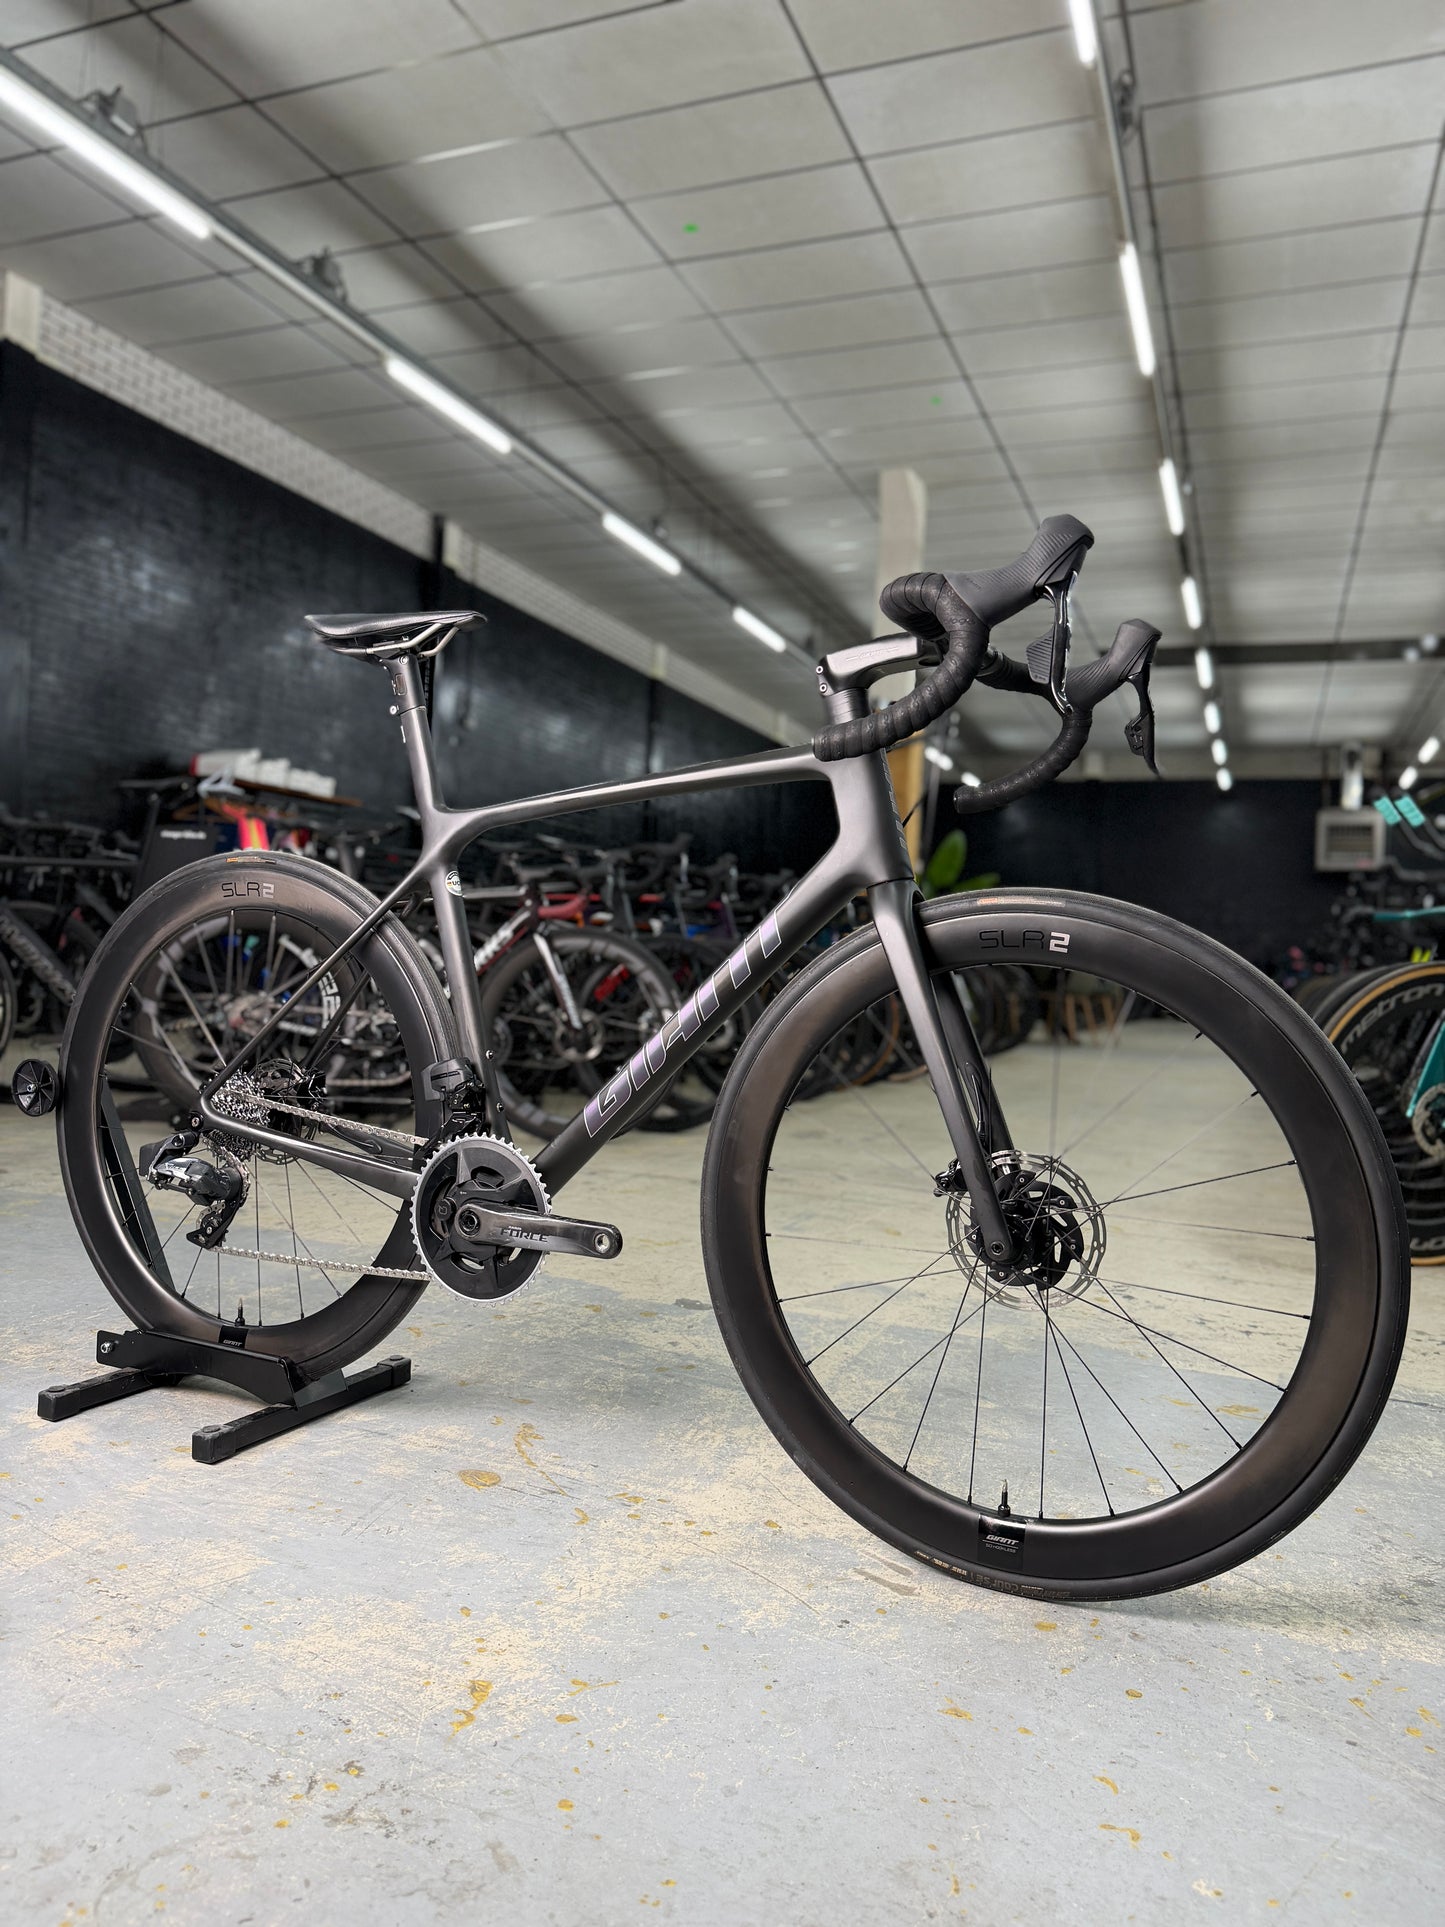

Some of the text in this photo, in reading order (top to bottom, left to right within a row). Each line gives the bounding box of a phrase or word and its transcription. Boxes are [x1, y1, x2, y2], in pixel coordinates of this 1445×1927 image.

[583, 882, 800, 1139] GIANT
[500, 1228, 548, 1243] FORCE
[223, 1339, 242, 1347] GIANT
[986, 1534, 1019, 1545] GIANT
